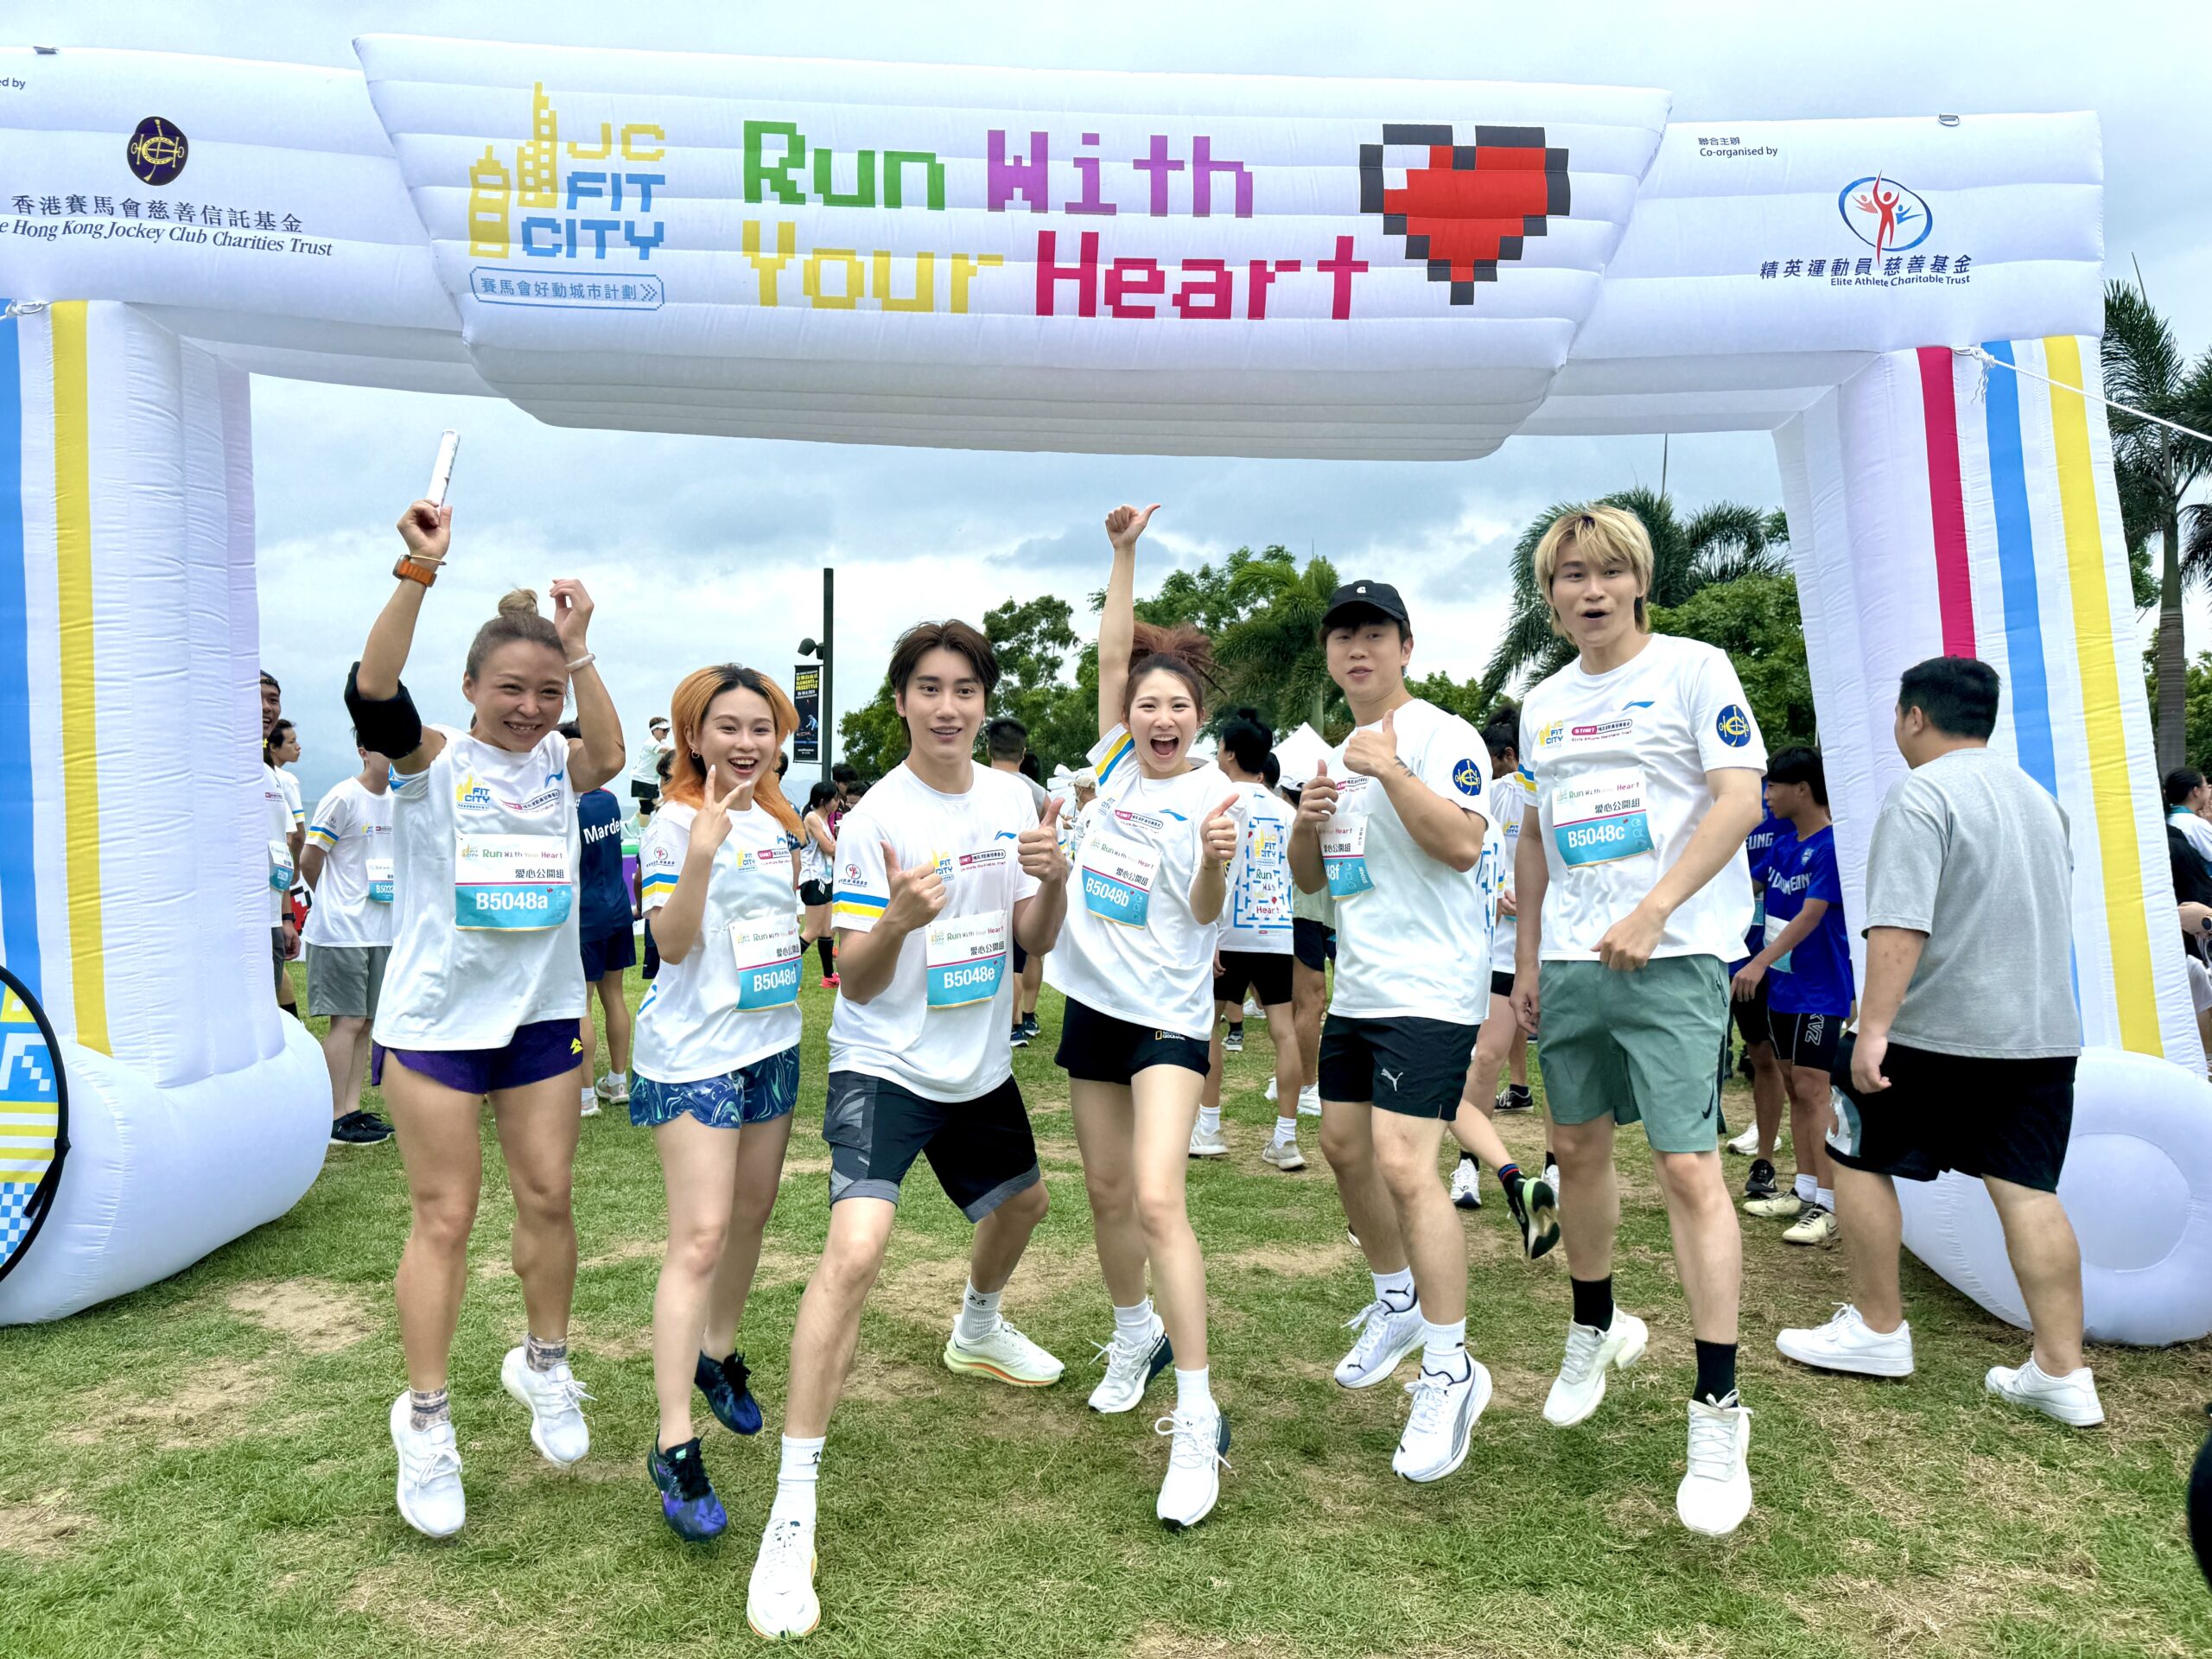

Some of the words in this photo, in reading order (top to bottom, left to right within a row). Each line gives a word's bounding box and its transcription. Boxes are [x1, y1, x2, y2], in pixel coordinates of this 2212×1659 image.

[0, 77, 10, 87] d
[12, 77, 26, 91] by
[567, 123, 665, 162] JC
[1700, 146, 1764, 159] Co-organised
[1765, 145, 1778, 157] by
[744, 119, 945, 211] Run
[987, 130, 1253, 218] With
[567, 171, 665, 213] FIT
[11, 194, 303, 233] 香港賽馬會慈善信託基金
[12, 219, 59, 242] Hong
[61, 219, 105, 239] Kong
[103, 221, 166, 244] Jockey
[168, 226, 207, 245] Club
[213, 231, 284, 251] Charities
[289, 238, 334, 257] Trust
[521, 216, 665, 261] CITY
[742, 219, 1004, 315] Your
[1036, 230, 1369, 321] Heart
[1831, 277, 1853, 286] Elite
[1854, 276, 1889, 288] Athlete
[1891, 273, 1944, 287] Charitable
[1945, 274, 1971, 285] Trust
[480, 277, 637, 302] 賽馬會好動城市計劃
[1546, 735, 1563, 745] CITY
[1550, 728, 1563, 736] FIT
[1568, 791, 1584, 799] Run
[1617, 781, 1640, 791] Heart
[464, 794, 490, 804] CITY
[1594, 798, 1641, 814] 愛心公開組
[1567, 823, 1625, 849] B5048c
[1100, 843, 1114, 855] Run
[1264, 842, 1276, 850] FIT
[482, 849, 502, 858] Run
[541, 851, 563, 860] Heart
[935, 866, 953, 875] CITY
[939, 858, 951, 868] FIT
[515, 868, 564, 879] 愛心公開組
[1255, 868, 1273, 880] Run
[1085, 876, 1130, 908] B5048b
[475, 891, 549, 911] B5048a
[1255, 905, 1281, 914] Heart
[753, 932, 768, 942] Run
[947, 932, 962, 941] Run
[988, 925, 1004, 934] Heart
[753, 965, 797, 993] B5048d
[944, 965, 995, 989] B5048e
